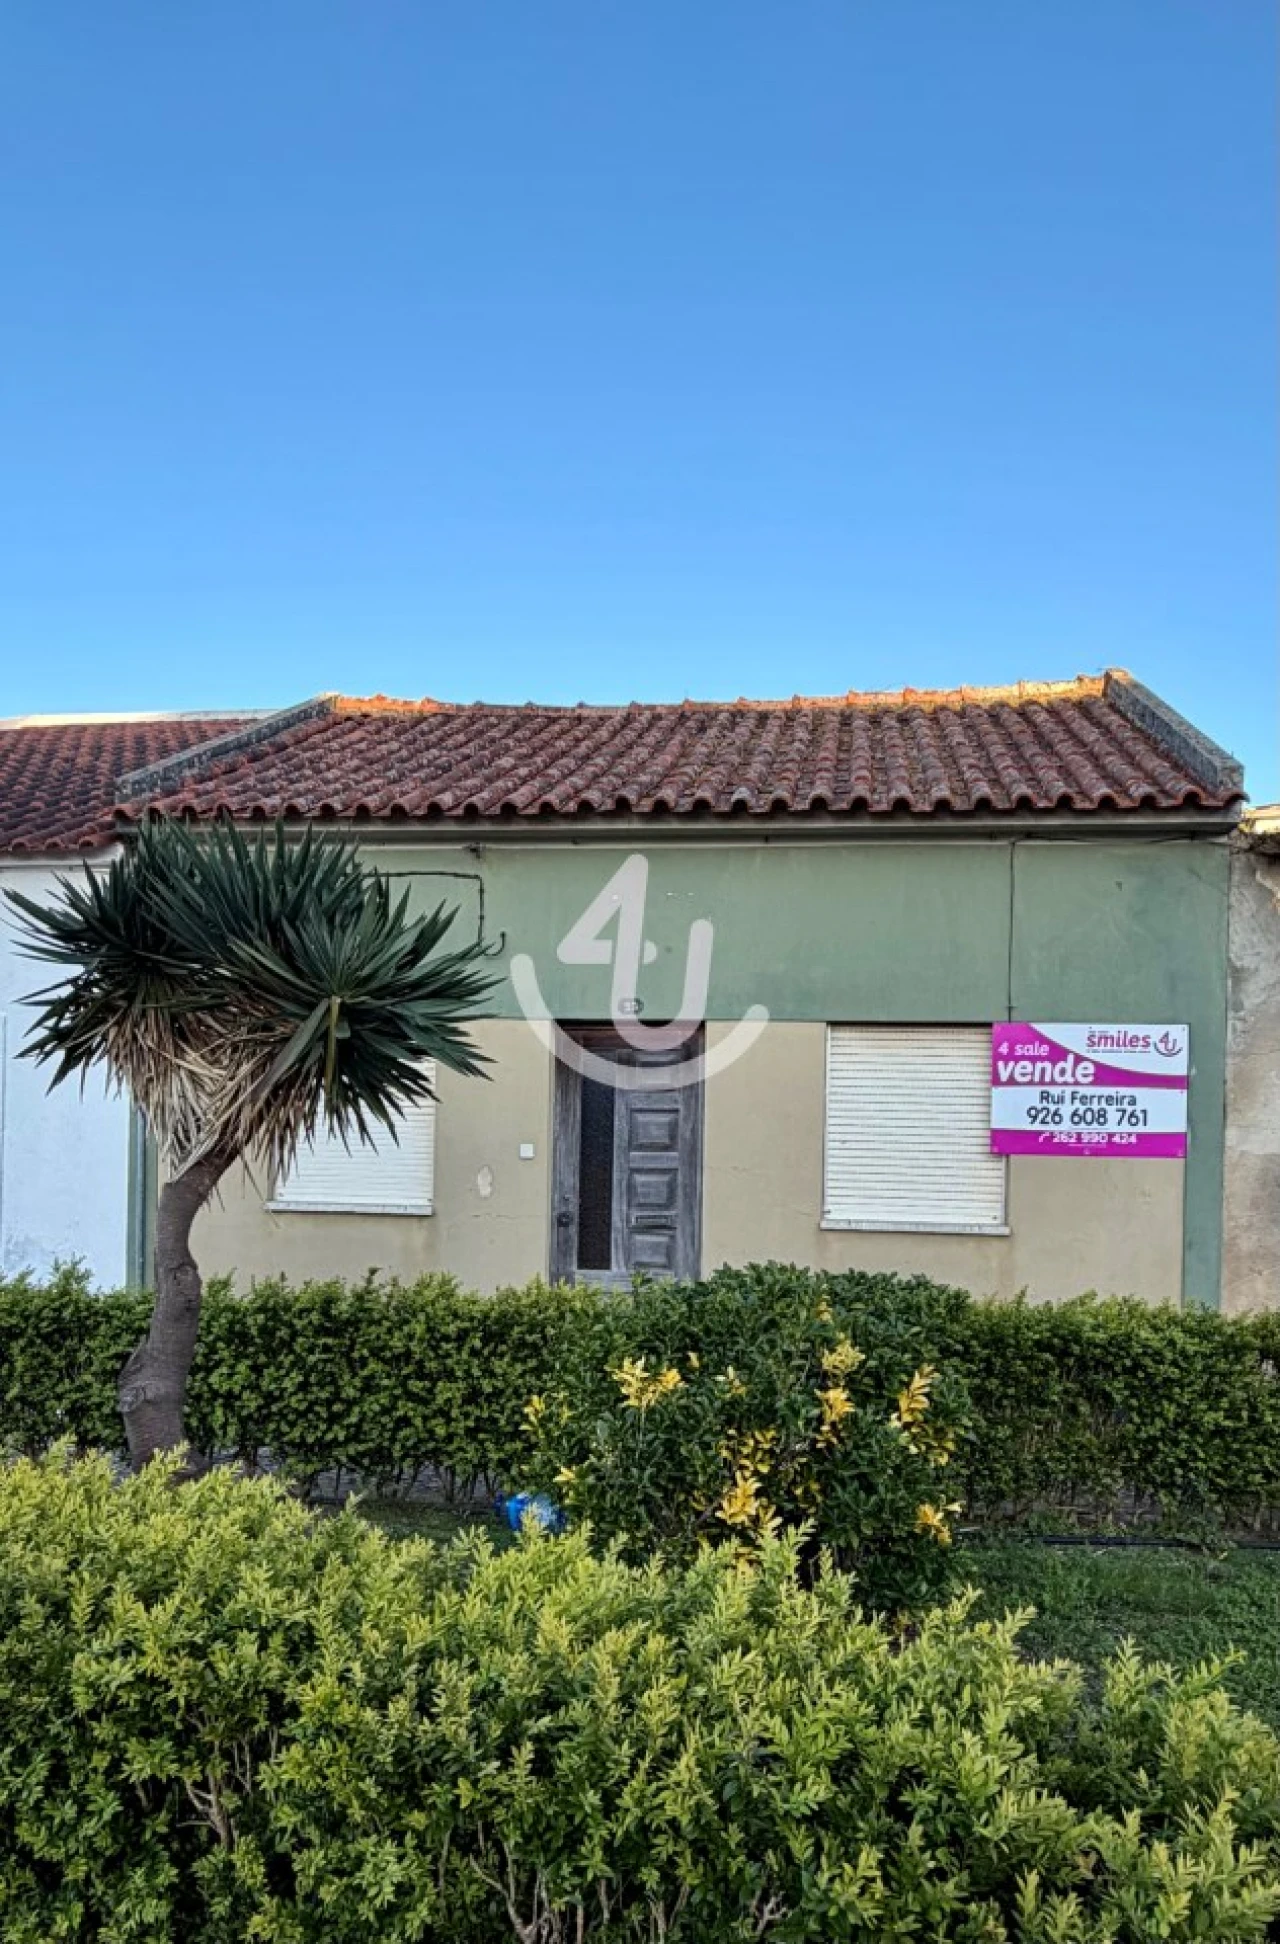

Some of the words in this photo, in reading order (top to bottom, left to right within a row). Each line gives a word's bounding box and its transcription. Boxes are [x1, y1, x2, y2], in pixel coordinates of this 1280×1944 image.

[1086, 1031, 1151, 1048] smiles
[997, 1042, 1009, 1056] 4
[1014, 1041, 1050, 1056] sale
[997, 1053, 1095, 1084] vende
[1039, 1090, 1066, 1106] Rui
[1070, 1091, 1137, 1107] Ferreira
[1026, 1106, 1063, 1126] 926
[1070, 1107, 1109, 1127] 608
[1115, 1109, 1148, 1127] 761
